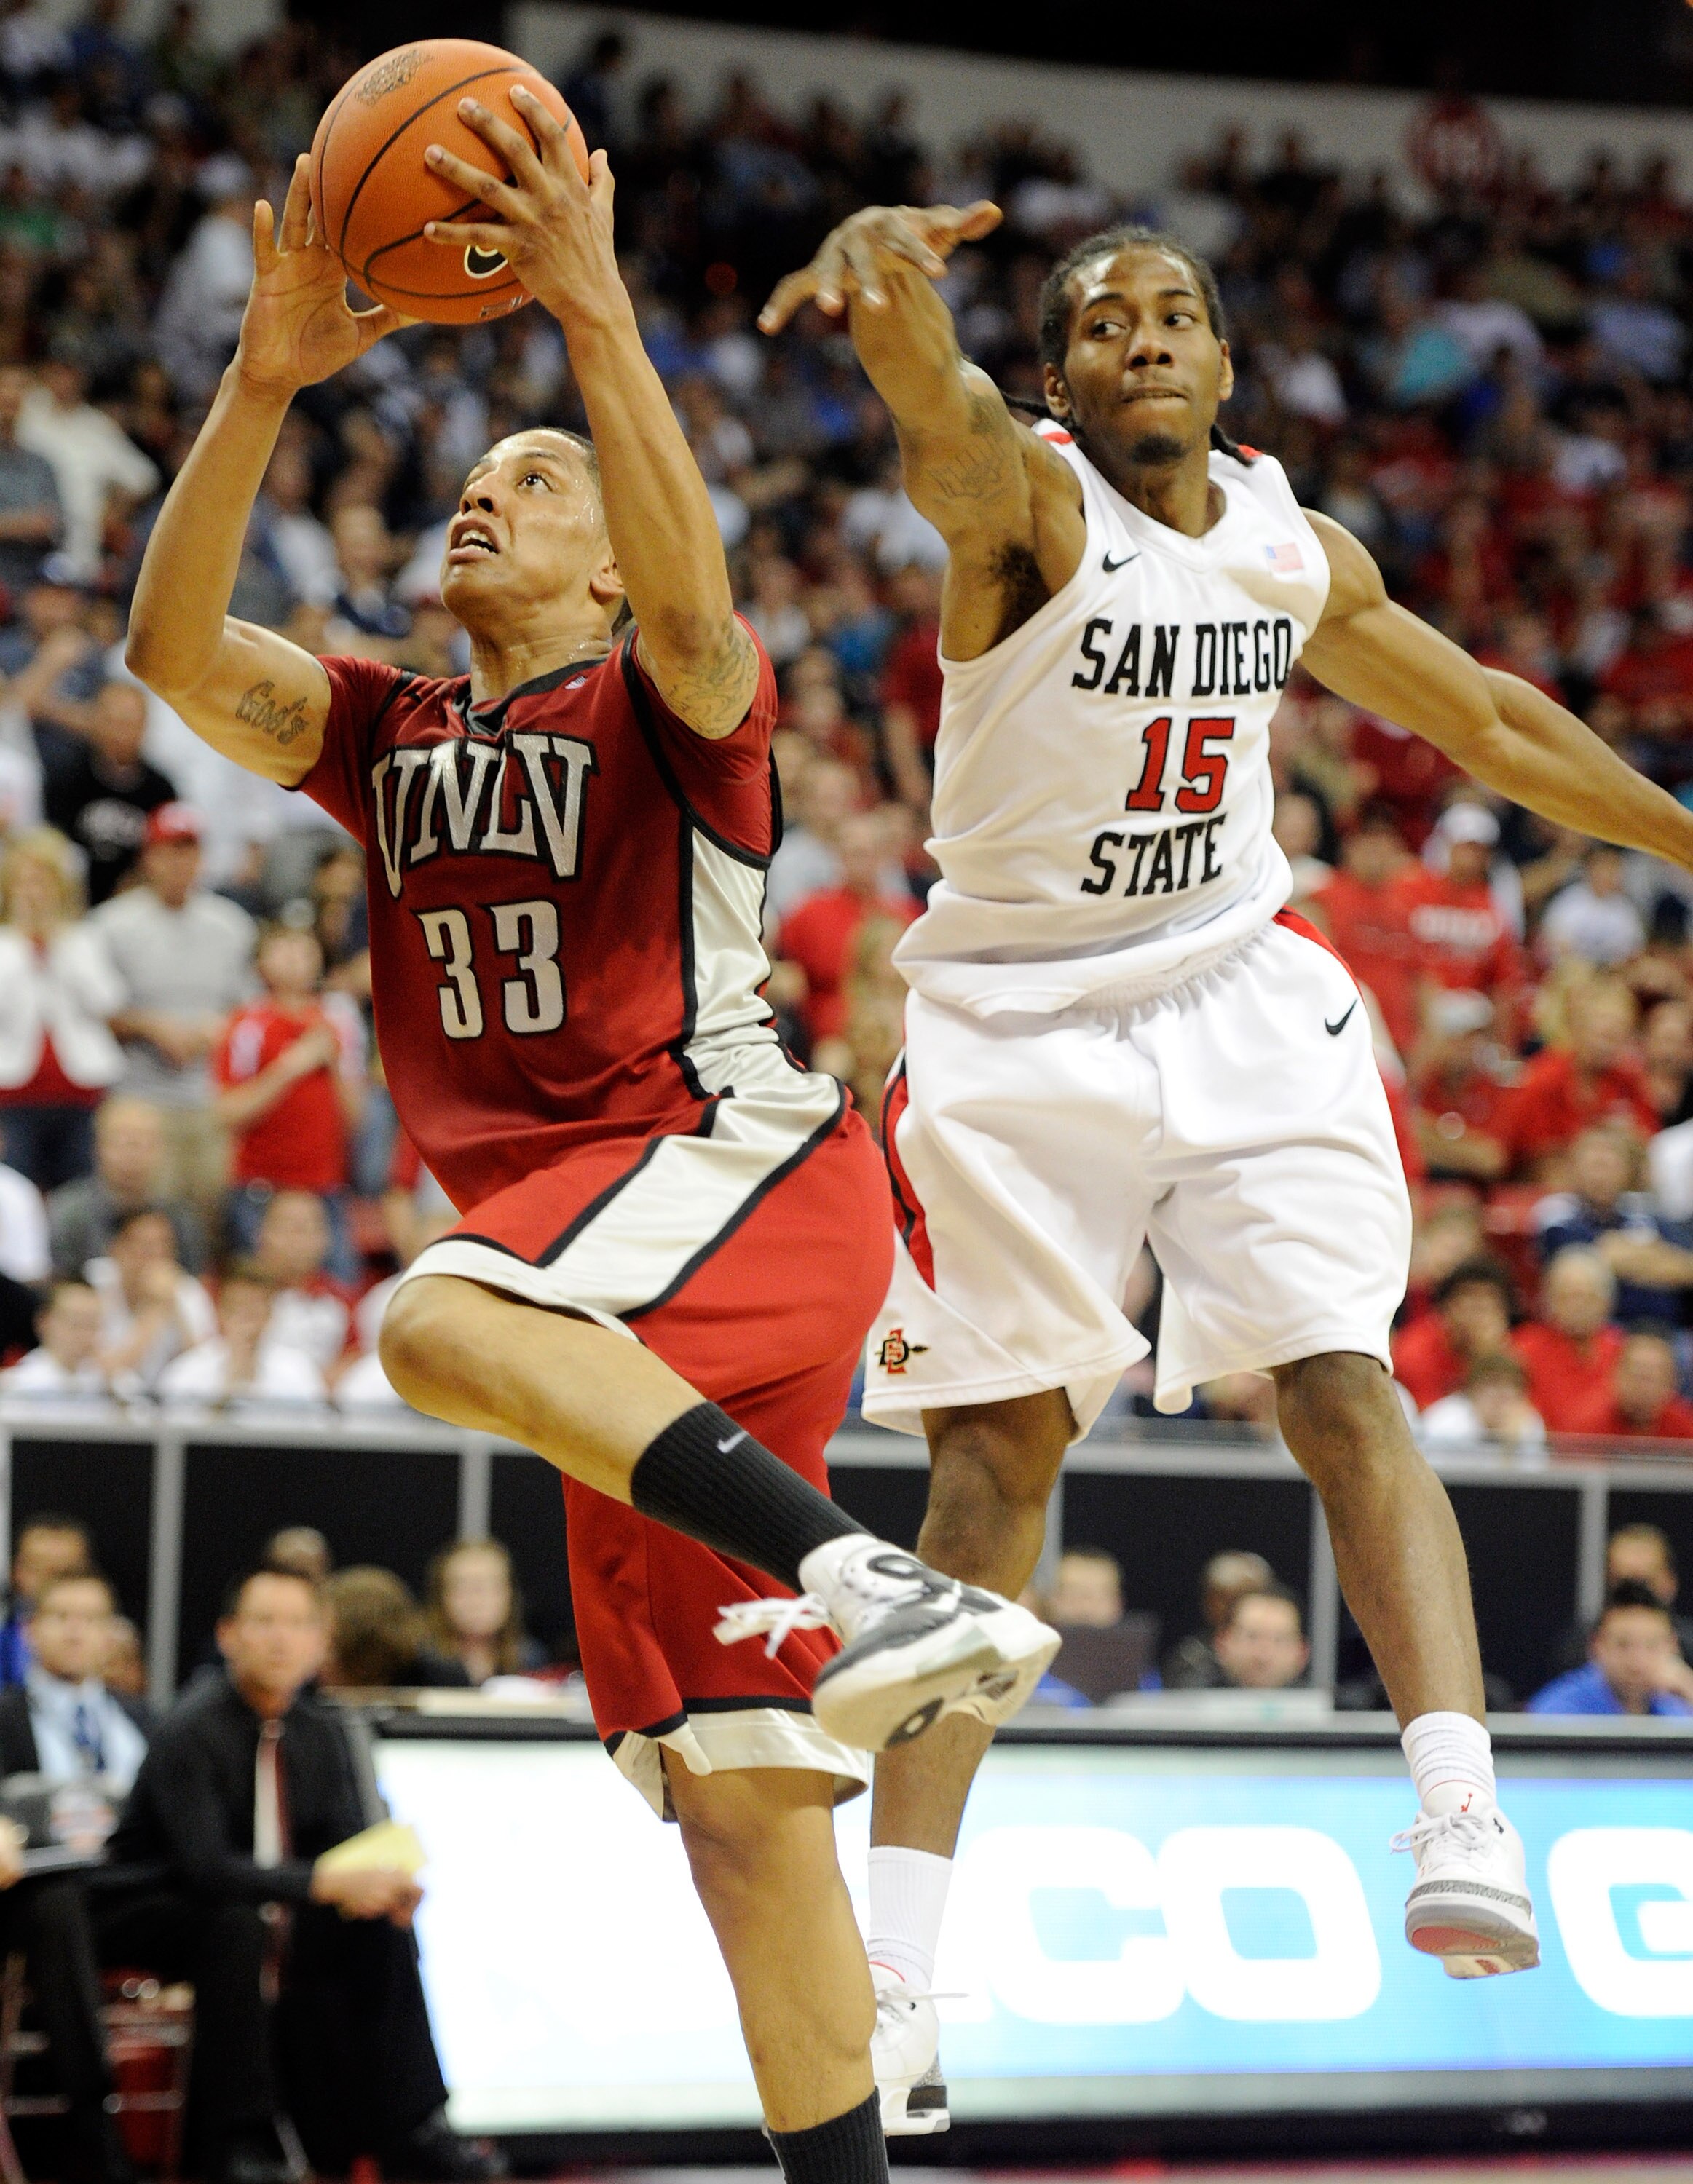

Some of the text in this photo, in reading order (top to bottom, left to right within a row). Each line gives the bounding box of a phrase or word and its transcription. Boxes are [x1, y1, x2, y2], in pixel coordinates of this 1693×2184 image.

[1072, 617, 1293, 697] SAN DIEGO
[1125, 716, 1236, 813] 15
[371, 729, 601, 898] UNLV
[1080, 812, 1226, 897] STATE
[412, 900, 564, 1040] 33
